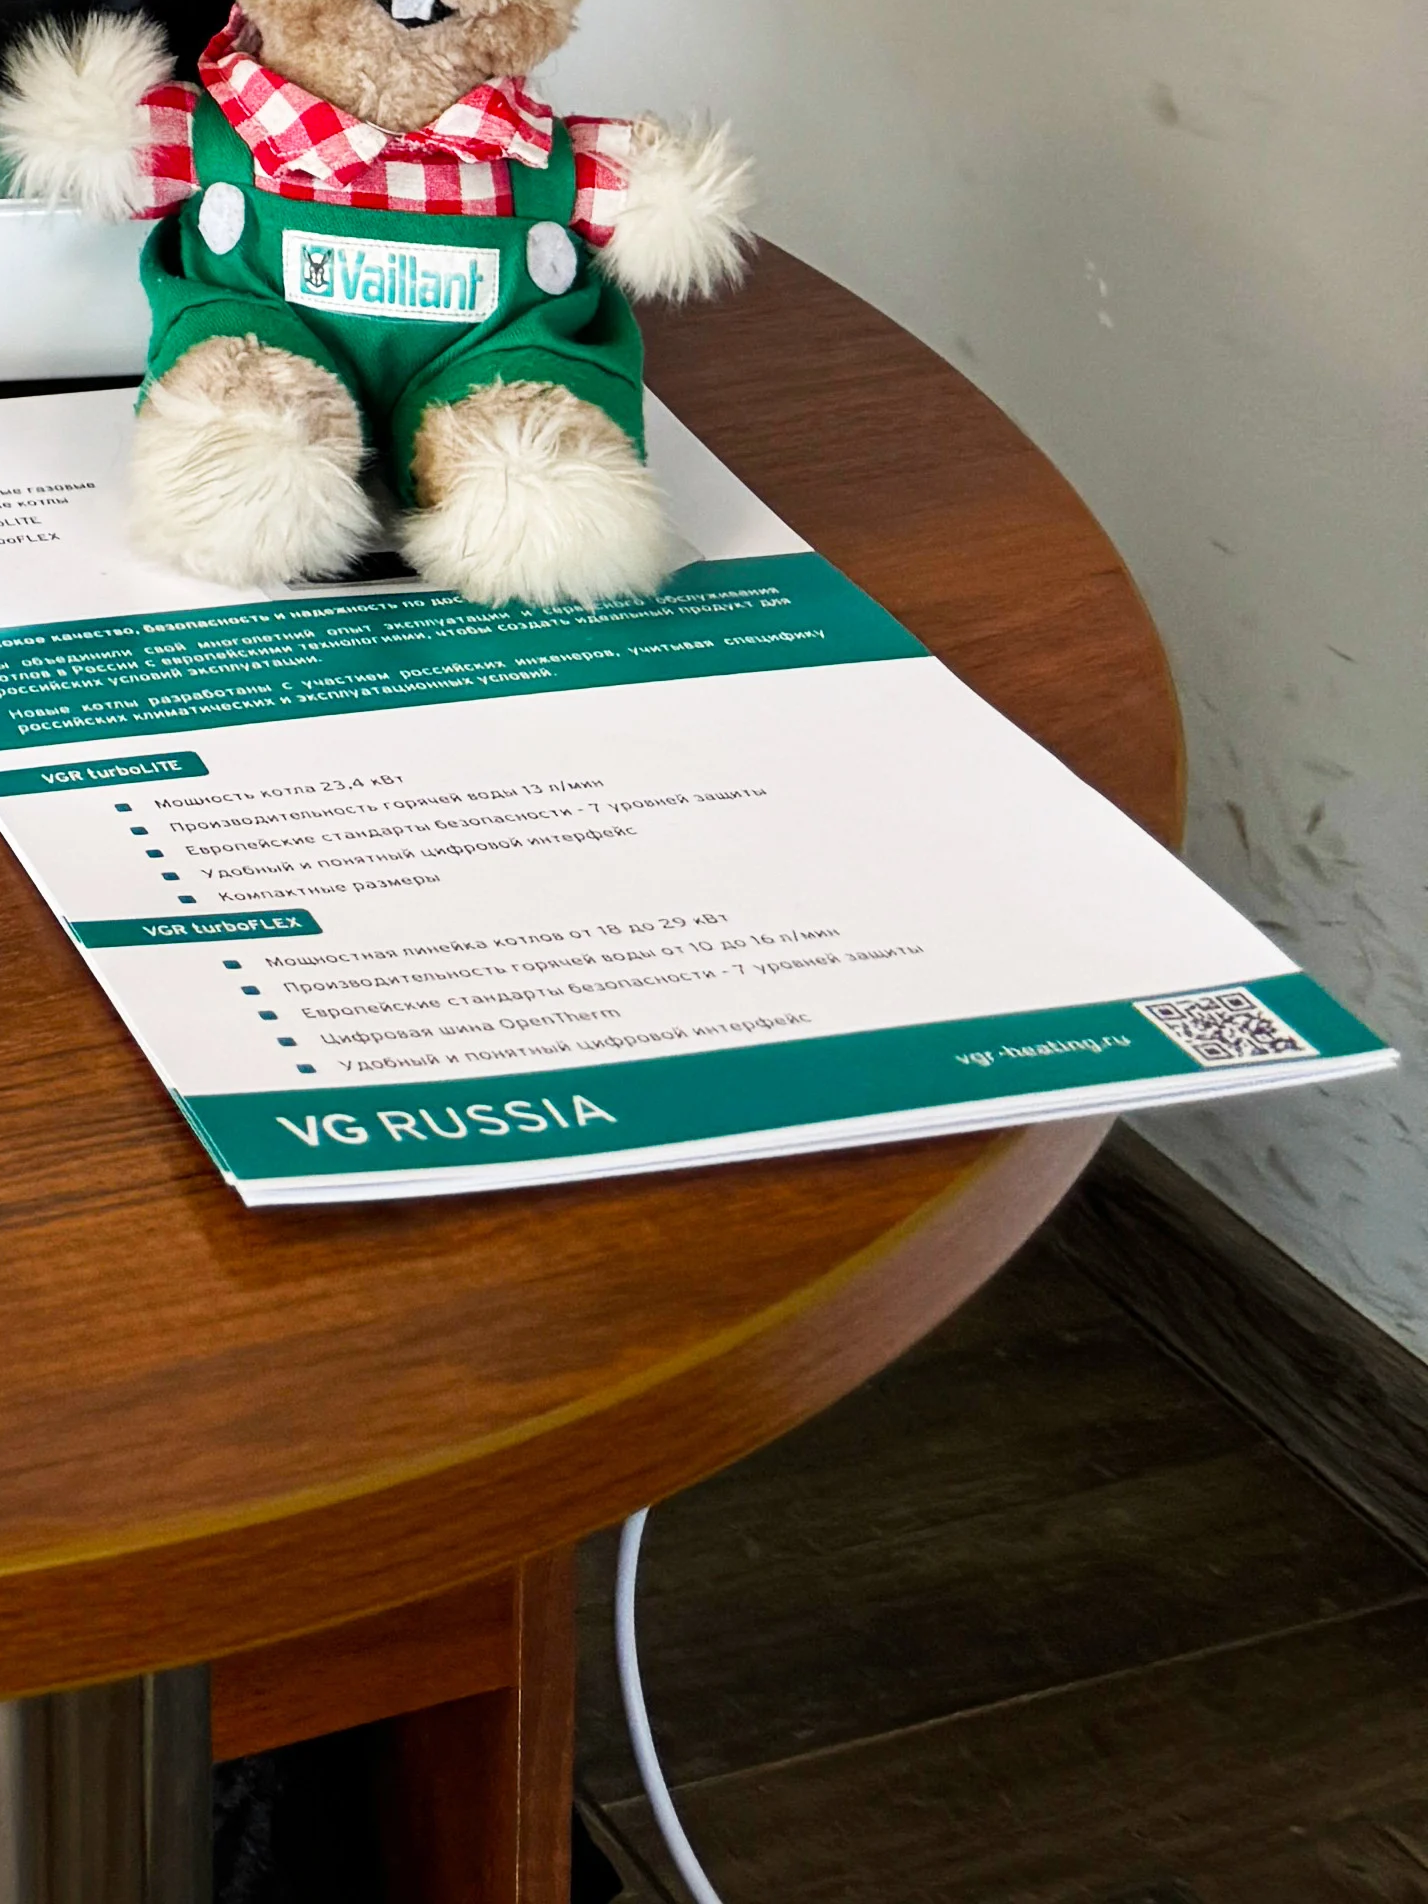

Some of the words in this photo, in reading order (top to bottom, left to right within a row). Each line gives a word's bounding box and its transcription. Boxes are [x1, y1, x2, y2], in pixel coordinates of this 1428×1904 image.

[337, 247, 485, 311] Vaillant
[955, 1034, 1132, 1068] vgr-heating.ru
[275, 1113, 370, 1147] VG
[376, 1094, 618, 1142] RUSSIA
